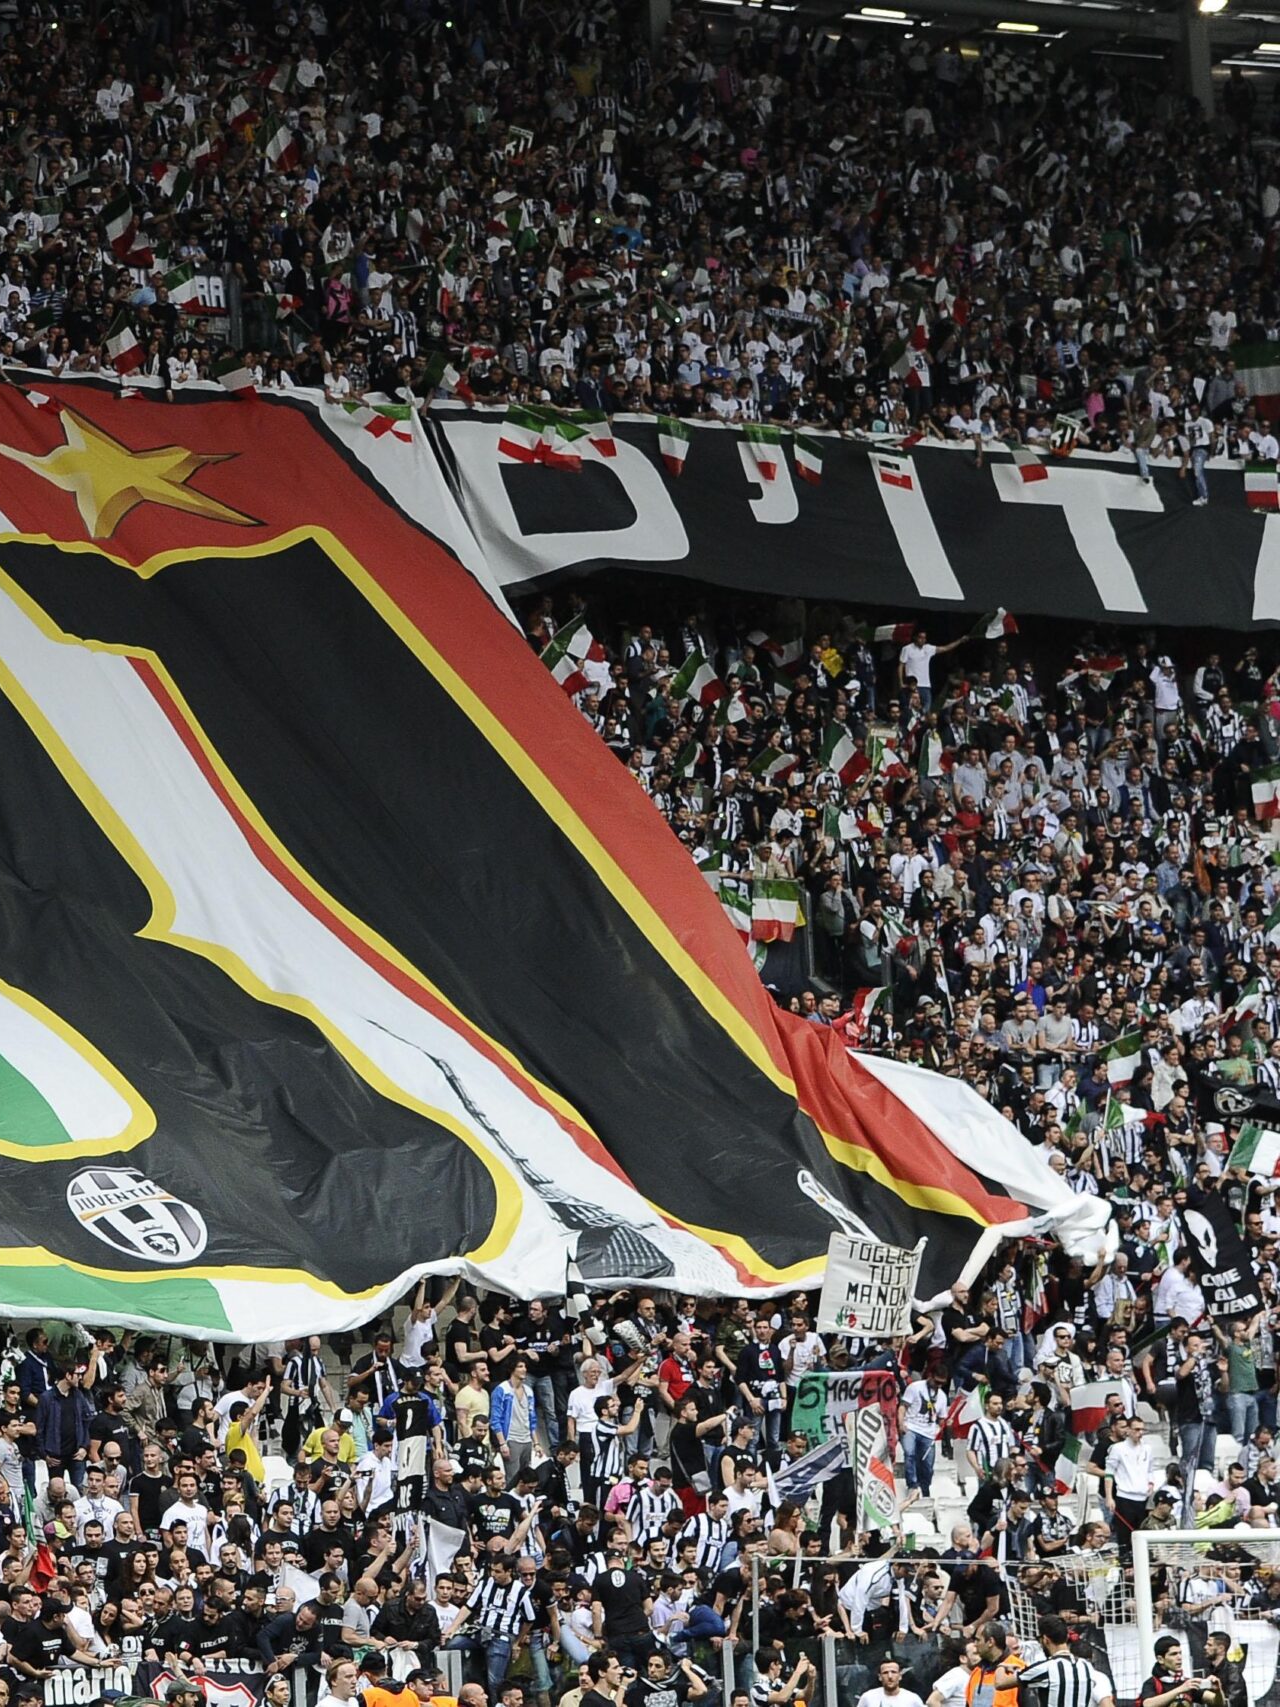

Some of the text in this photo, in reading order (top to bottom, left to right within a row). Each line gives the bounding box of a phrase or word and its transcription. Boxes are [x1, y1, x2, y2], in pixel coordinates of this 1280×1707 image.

[861, 1307, 903, 1332] JUVE
[798, 1377, 897, 1409] 5 MAGGIO
[44, 1665, 132, 1706] mario
